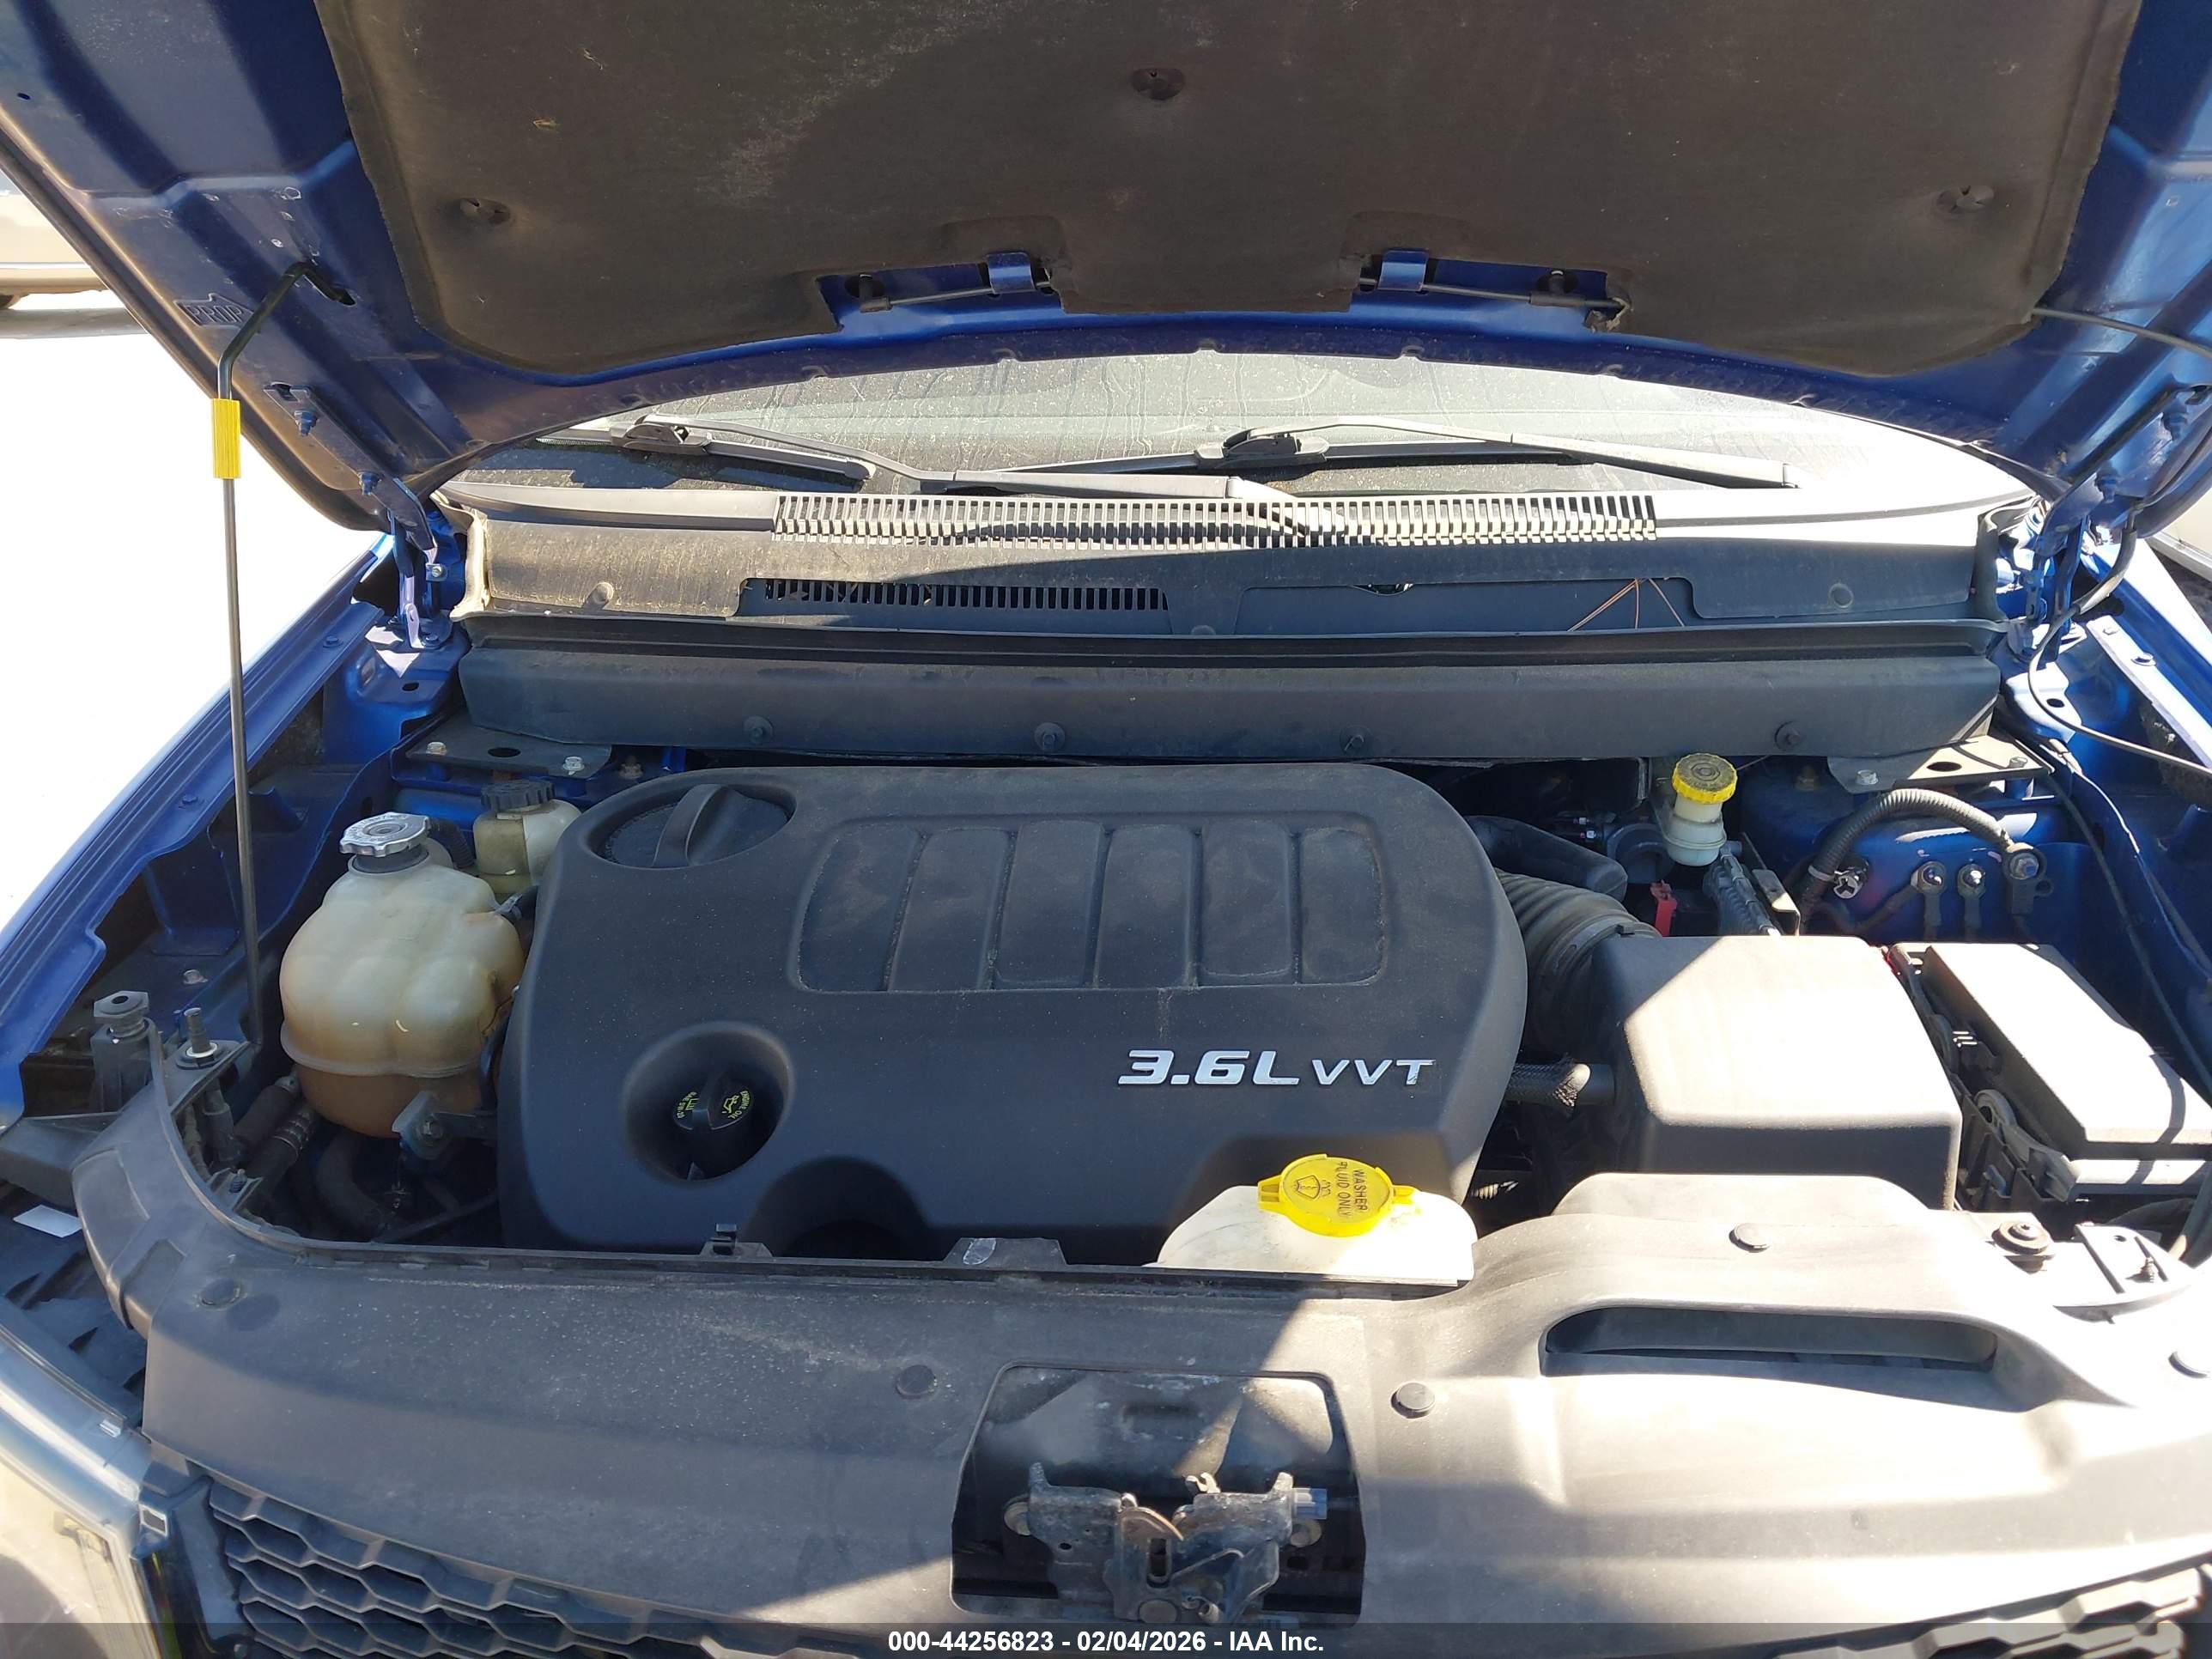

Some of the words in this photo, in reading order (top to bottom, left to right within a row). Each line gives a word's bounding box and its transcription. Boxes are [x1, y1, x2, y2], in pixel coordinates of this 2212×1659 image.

[1117, 1049, 1300, 1085] 3.6L
[1311, 1059, 1437, 1085] VVT
[1335, 1161, 1350, 1189] FLUID
[1352, 1169, 1368, 1212] WASHER
[1338, 1192, 1352, 1217] ONLY
